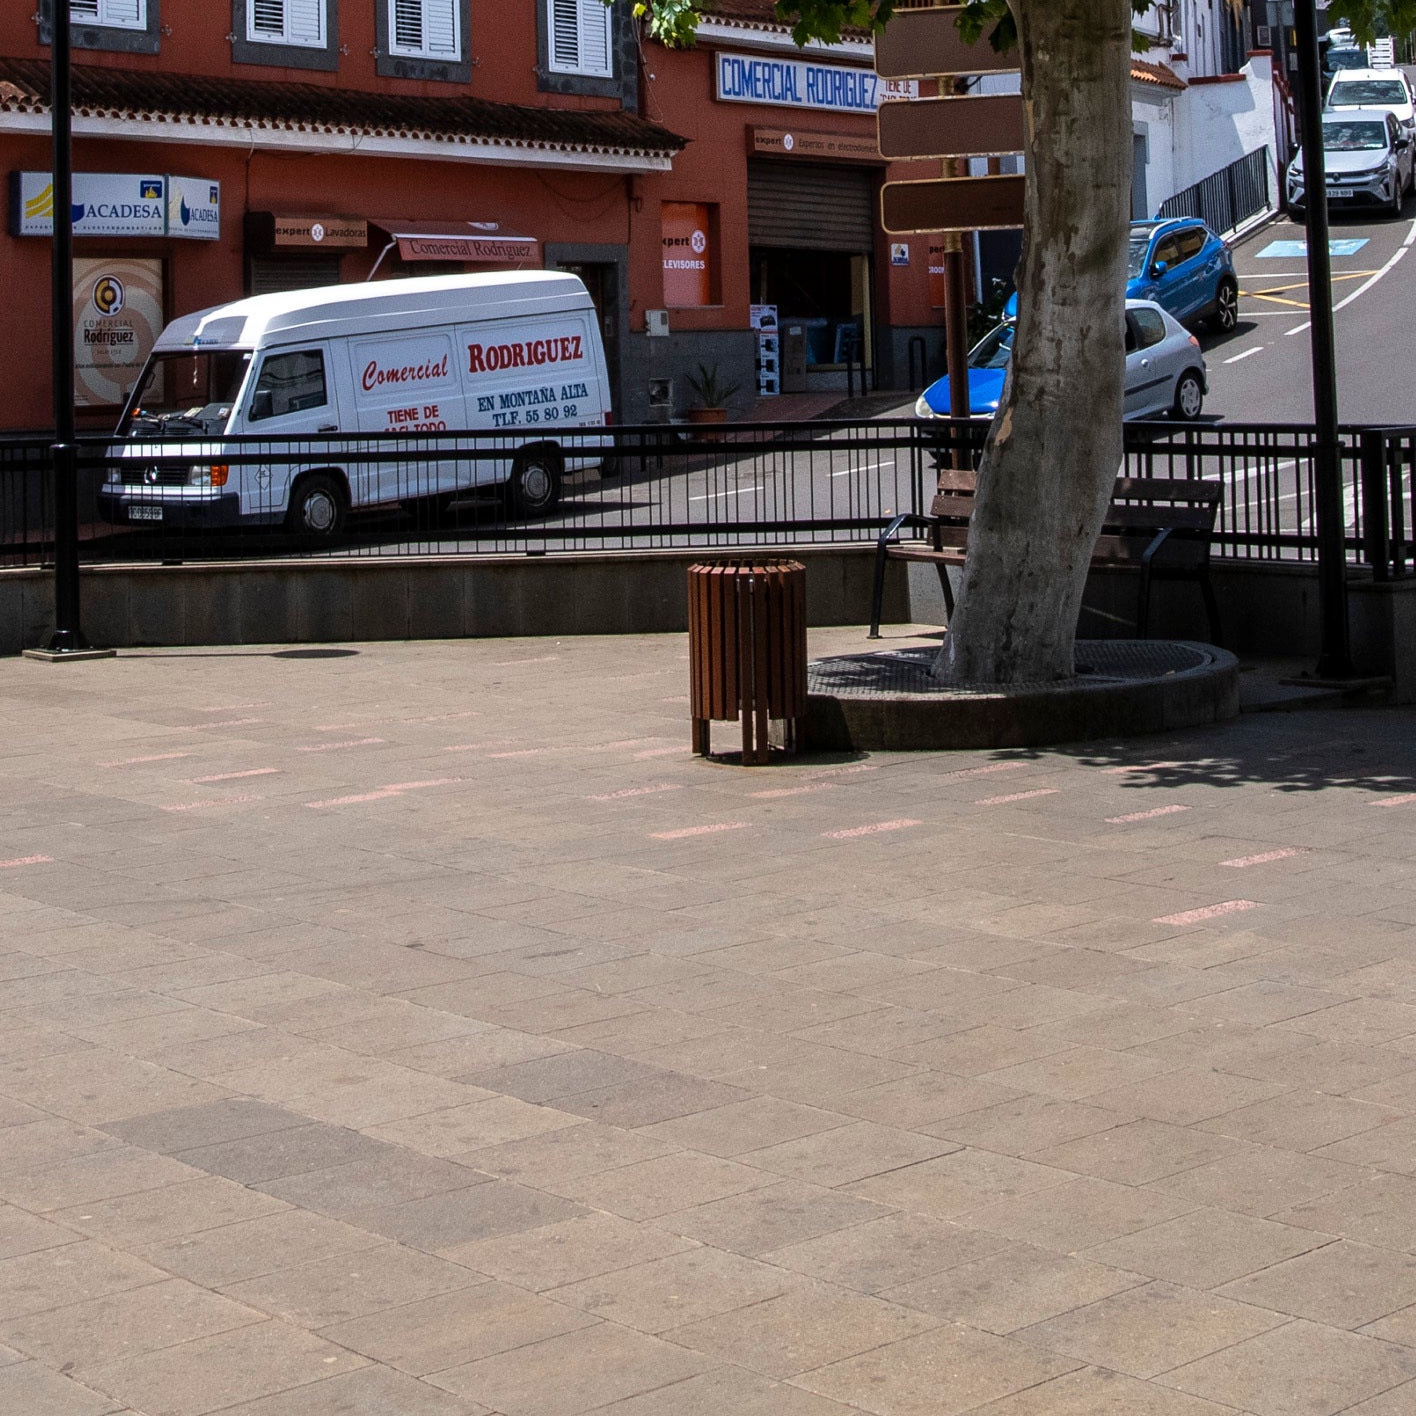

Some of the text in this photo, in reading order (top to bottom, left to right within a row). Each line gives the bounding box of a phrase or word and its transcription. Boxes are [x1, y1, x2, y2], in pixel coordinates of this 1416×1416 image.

[721, 58, 878, 109] COMERCIAL RODRIGUEZ
[86, 204, 162, 219] ACADESA
[190, 208, 218, 222] ACADESA
[276, 227, 366, 238] expert Lavadoras
[409, 240, 472, 257] Comercial
[663, 259, 706, 269] LEVISORES
[84, 327, 134, 345] Rodríguez
[467, 335, 583, 373] RODRIGUEZ
[361, 353, 449, 391] Comercial
[477, 383, 588, 412] EN MONTAÑA ALTA
[387, 405, 439, 424] TIENE DE
[525, 409, 540, 423] 55
[544, 406, 559, 421] 80
[564, 404, 578, 418] 92
